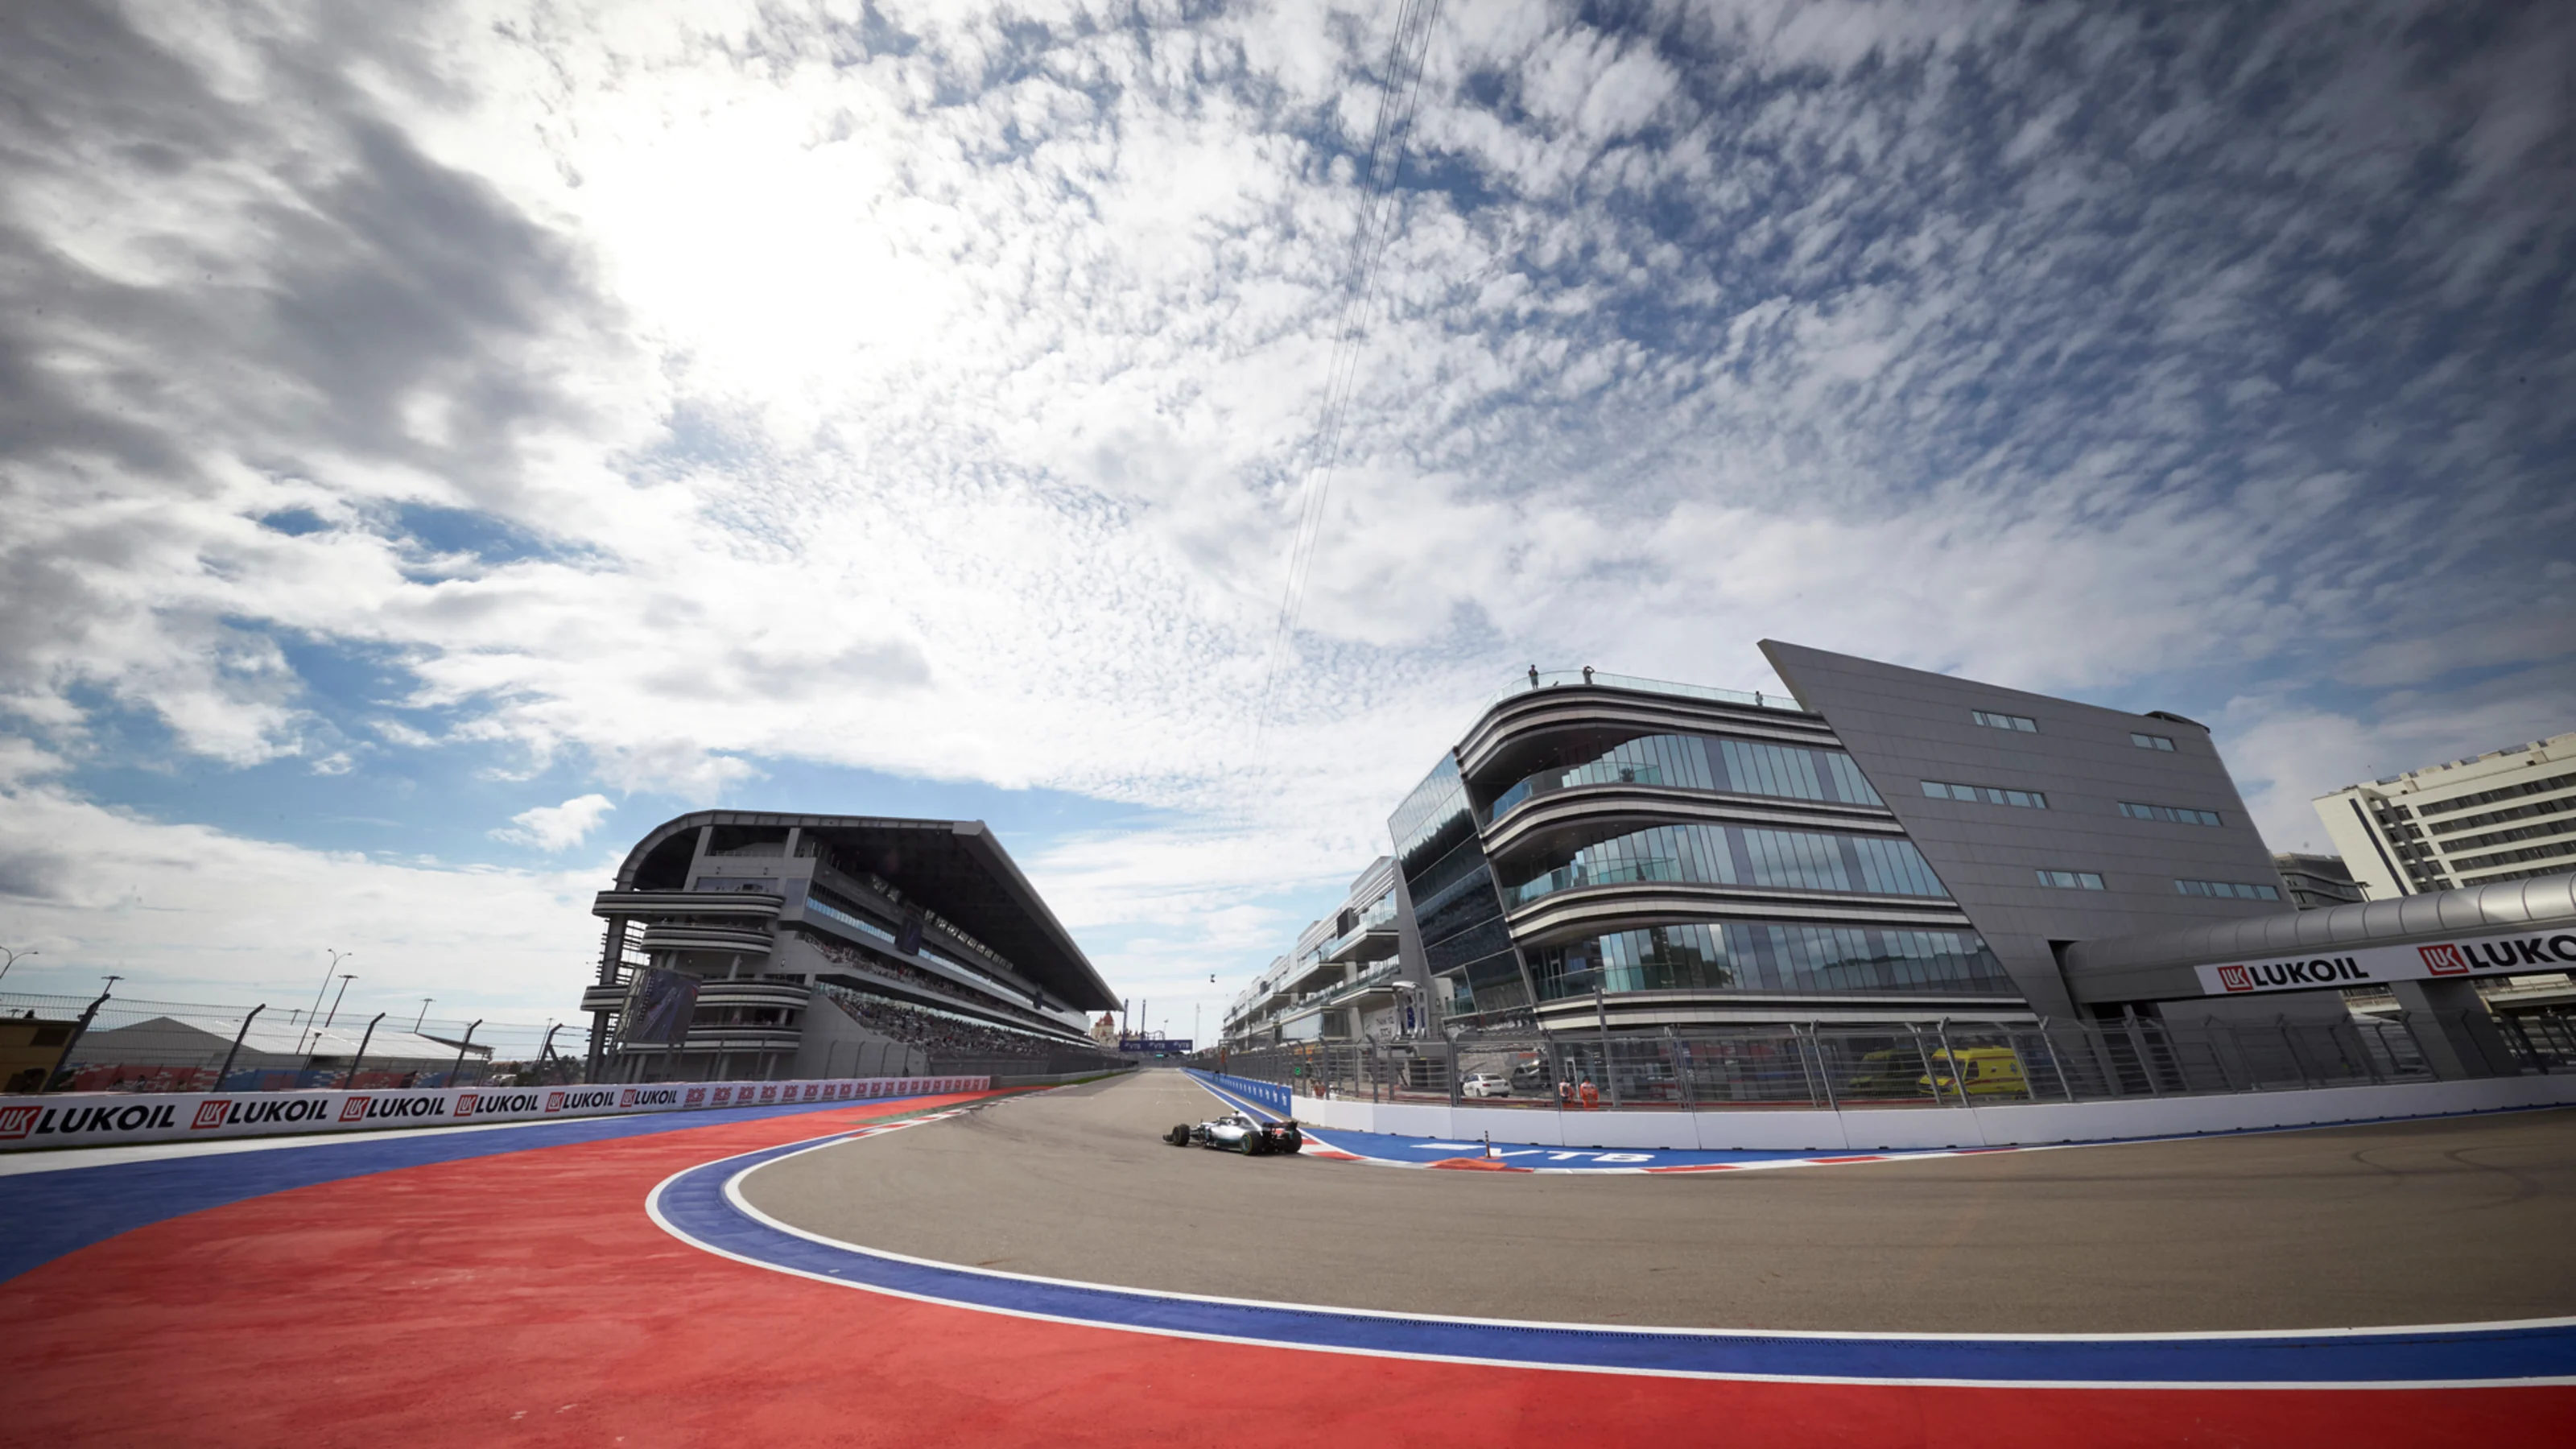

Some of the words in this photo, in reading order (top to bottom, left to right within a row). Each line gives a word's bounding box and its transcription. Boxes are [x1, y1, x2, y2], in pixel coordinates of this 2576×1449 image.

[2248, 957, 2370, 986] LUKOIL
[365, 1096, 445, 1117] LUKOIL
[475, 1094, 539, 1113] LUKOIL
[563, 1092, 615, 1108] LUKOIL
[634, 1090, 678, 1104] LUKOIL
[35, 1104, 176, 1134] LUKOIL
[226, 1100, 328, 1124] LUKOIL
[1488, 1147, 1656, 1162] VTB
